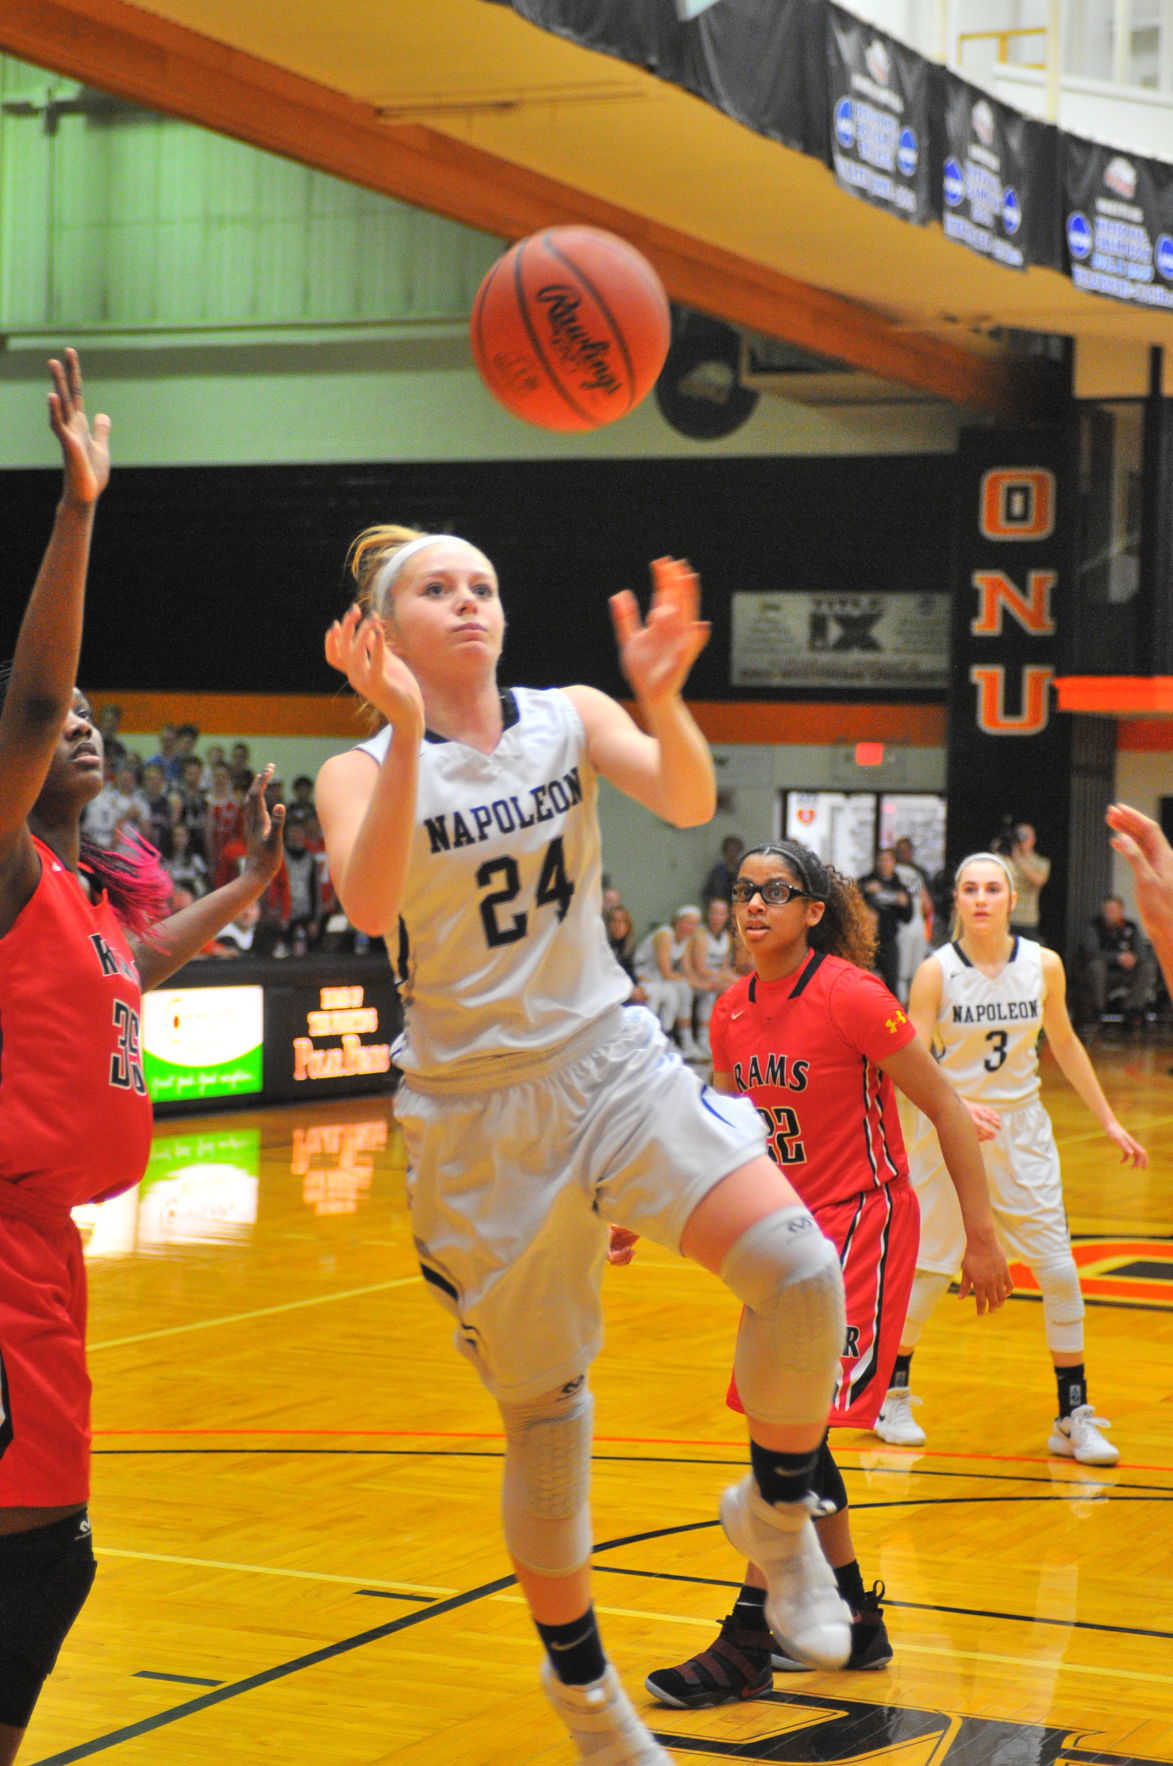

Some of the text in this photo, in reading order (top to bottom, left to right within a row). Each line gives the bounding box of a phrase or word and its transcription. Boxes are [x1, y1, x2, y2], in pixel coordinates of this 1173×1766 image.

[535, 283, 622, 396] Rawlings
[808, 611, 884, 652] IX
[424, 766, 583, 854] NAPOLEON
[475, 834, 576, 949] 24
[952, 1000, 1038, 1024] NAPOLEON
[983, 1029, 1008, 1073] 3
[733, 1053, 810, 1095] RAMS
